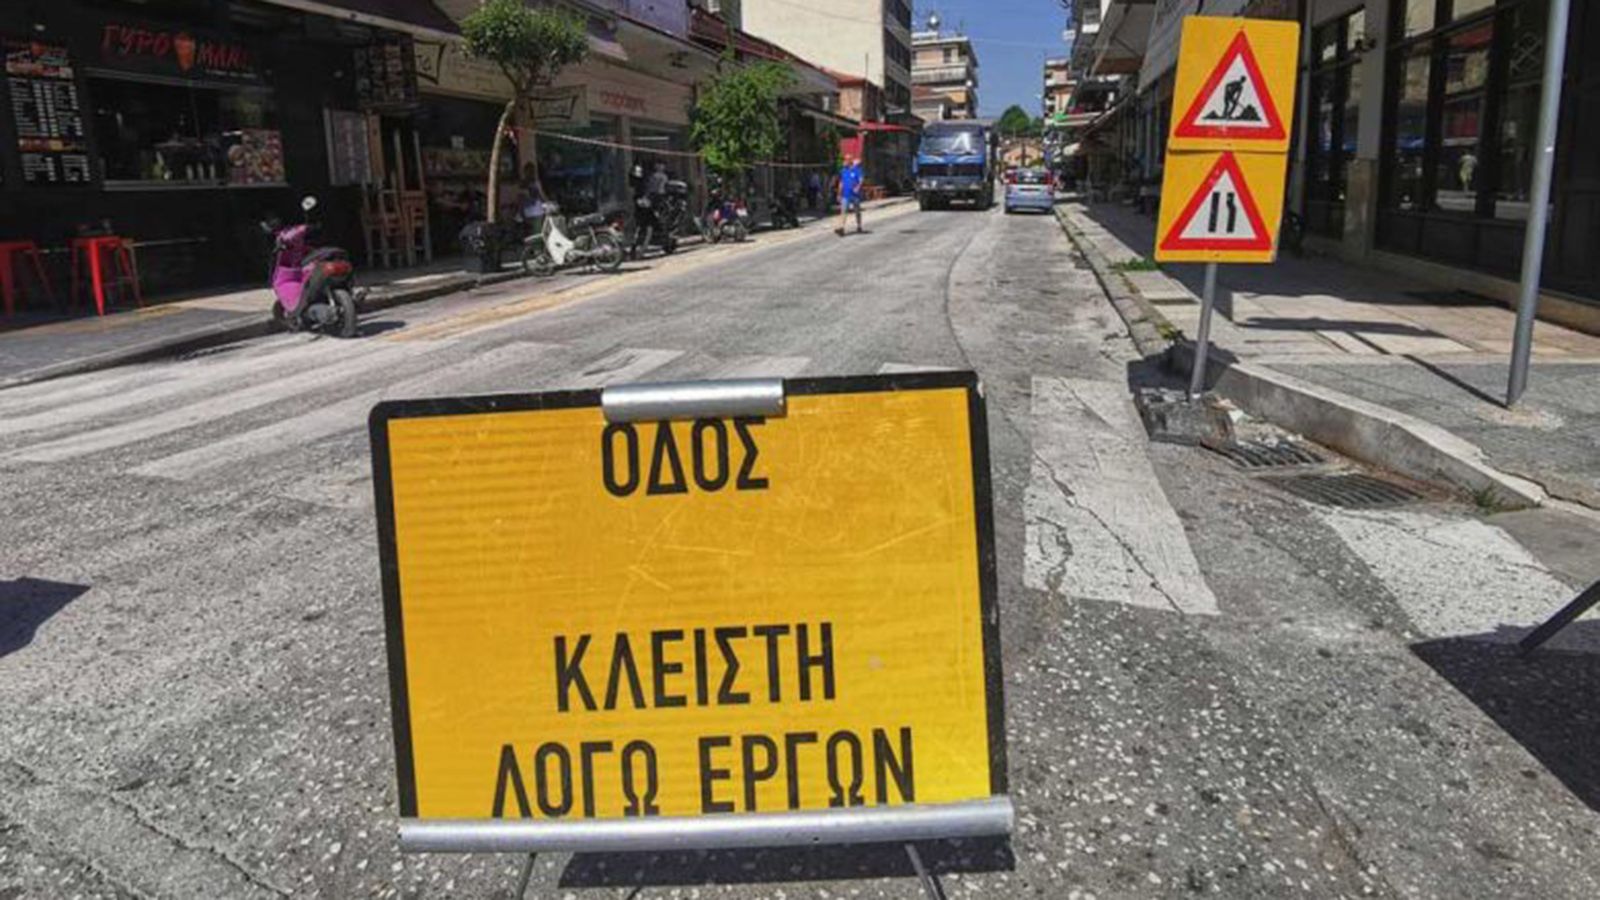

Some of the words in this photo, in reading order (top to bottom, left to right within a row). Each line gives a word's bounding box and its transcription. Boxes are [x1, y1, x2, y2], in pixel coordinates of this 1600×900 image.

[602, 416, 769, 496] ΟΔΟΣ
[553, 622, 836, 713] ΚΛΕΙΣΤΗ
[492, 740, 659, 818] ΛΟΓΩ
[698, 727, 915, 814] ΕΡΓΩΝ
